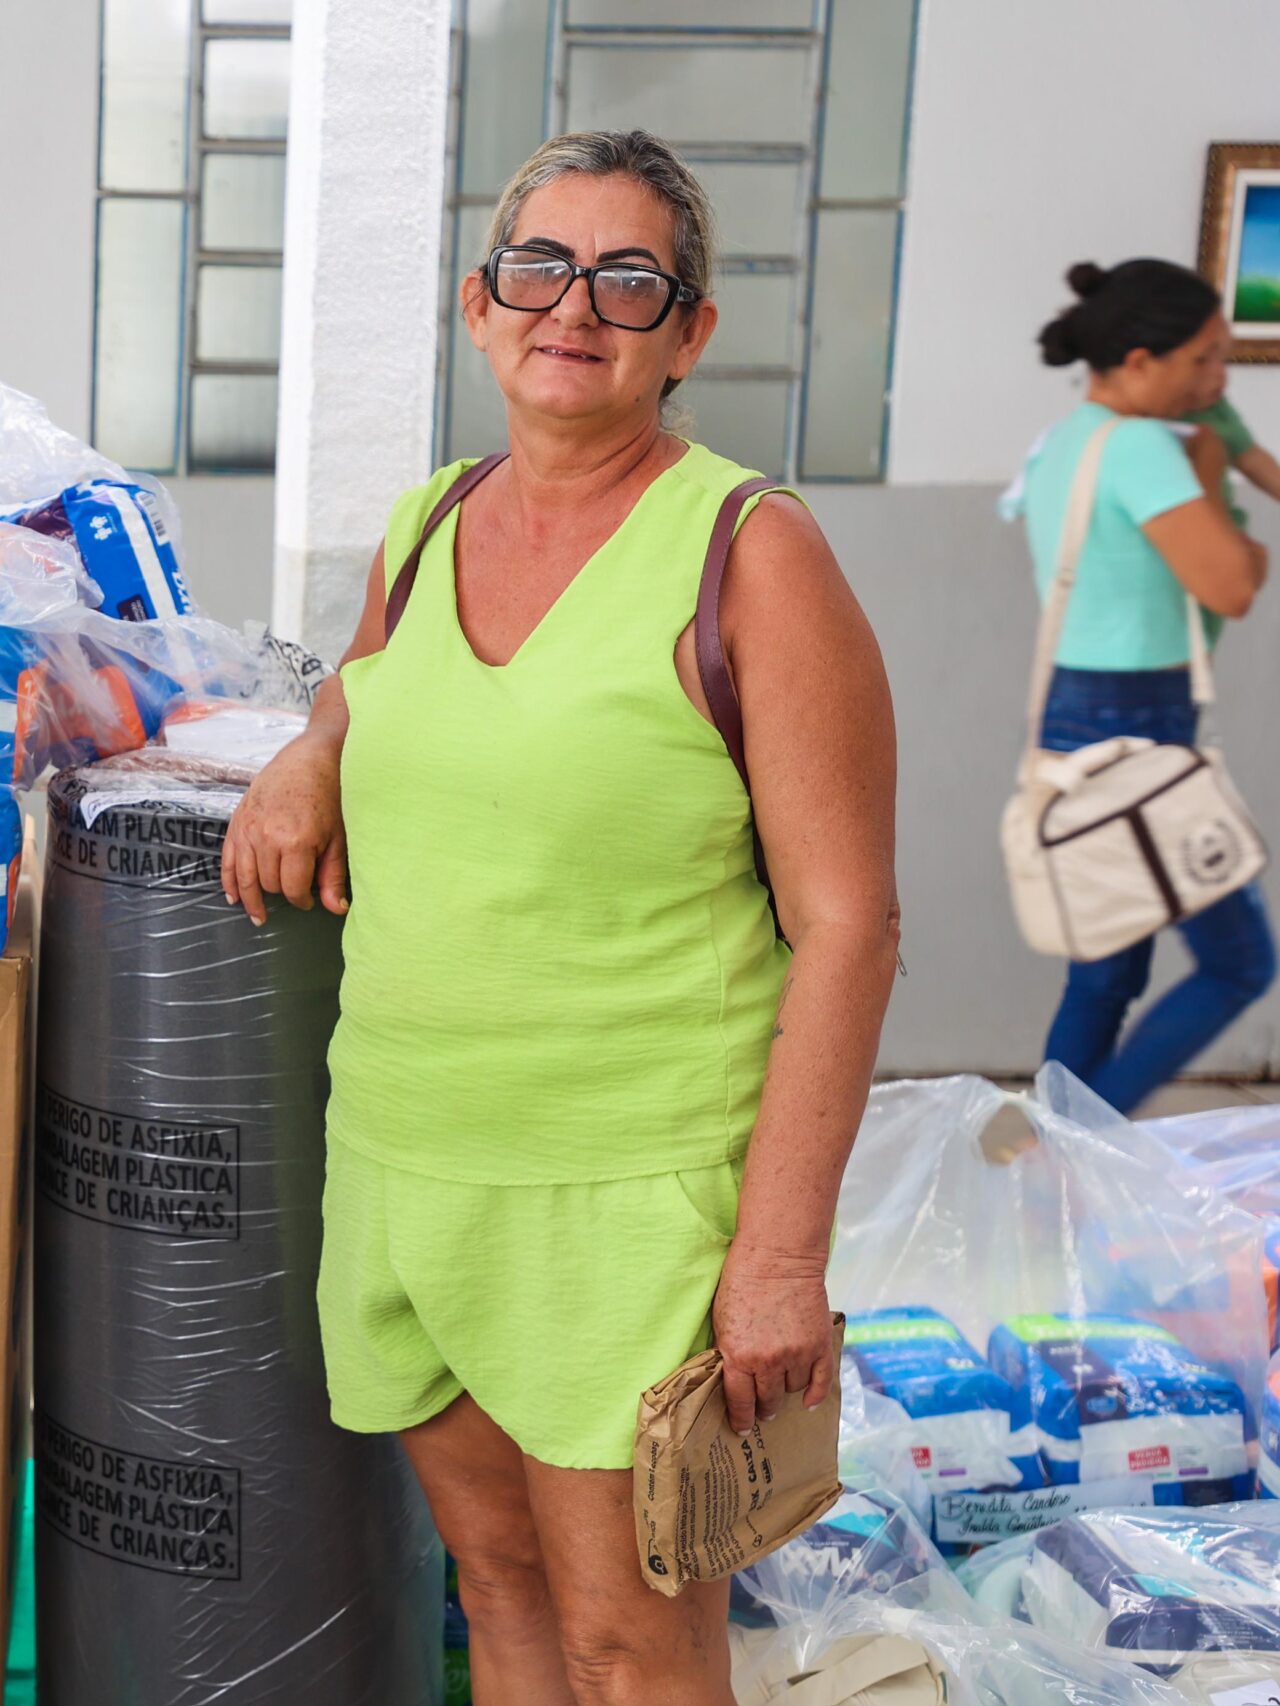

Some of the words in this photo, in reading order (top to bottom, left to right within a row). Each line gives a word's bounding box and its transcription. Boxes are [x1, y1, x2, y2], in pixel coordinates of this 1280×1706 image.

[78, 837, 97, 867] DE
[99, 1116, 123, 1148] DE
[130, 1124, 232, 1164] ASFIXIA,
[126, 1157, 233, 1195] PLÁSTICA
[76, 1177, 96, 1209] DE
[107, 1187, 234, 1232] CRIANÇAS.
[102, 1452, 126, 1484] DE
[134, 1462, 232, 1506] ASFIXIA,
[740, 1439, 757, 1483] CAIXA
[647, 1474, 658, 1502] Contém
[129, 1494, 234, 1536] PLÁSTICA
[78, 1510, 100, 1543] DE
[111, 1523, 234, 1572] CRIANÇAS.
